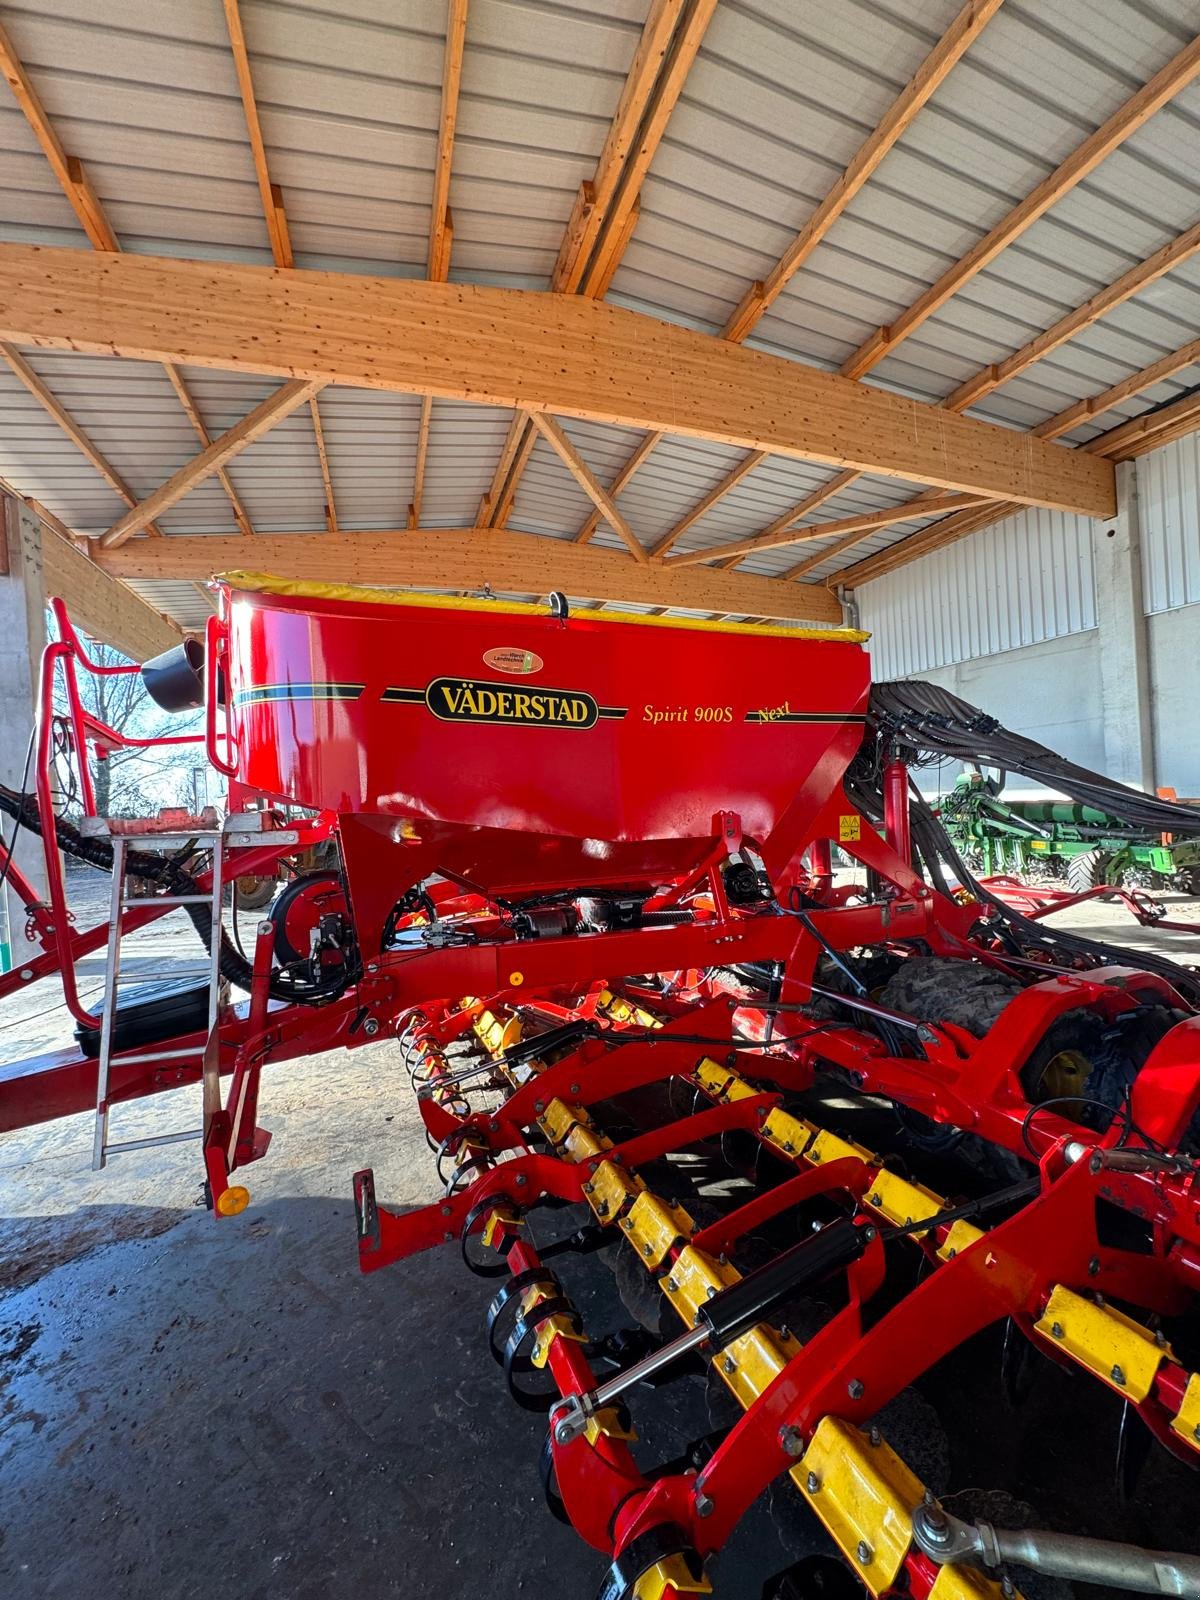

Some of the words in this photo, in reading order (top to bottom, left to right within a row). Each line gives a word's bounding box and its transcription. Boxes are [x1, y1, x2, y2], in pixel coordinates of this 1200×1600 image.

[441, 683, 588, 722] VÄDERSTAD
[642, 704, 688, 725] Spirit
[694, 706, 733, 723] 900S
[758, 701, 791, 725] Next
